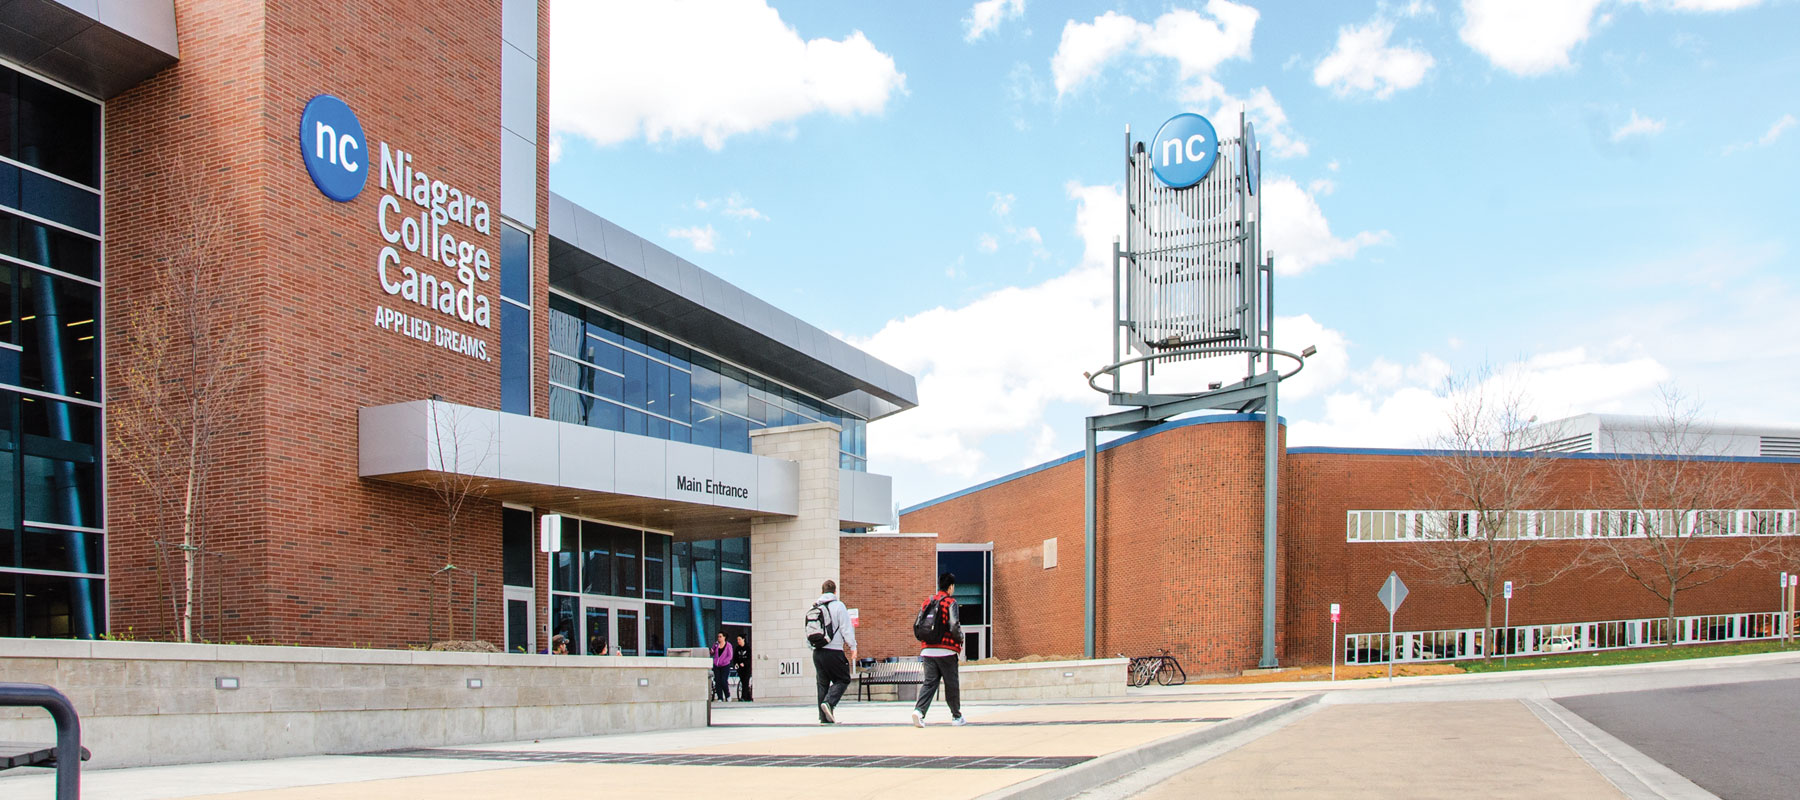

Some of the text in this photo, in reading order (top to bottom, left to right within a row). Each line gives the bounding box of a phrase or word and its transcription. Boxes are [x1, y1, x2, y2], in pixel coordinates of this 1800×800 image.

[316, 120, 358, 172] nc
[1162, 134, 1206, 167] nc
[379, 141, 490, 235] Niagara
[378, 194, 490, 284] College
[377, 246, 490, 328] Canada
[374, 305, 491, 362] APPLIED DREAMS.
[677, 475, 748, 499] Main Entrance
[780, 662, 800, 675] 2011
